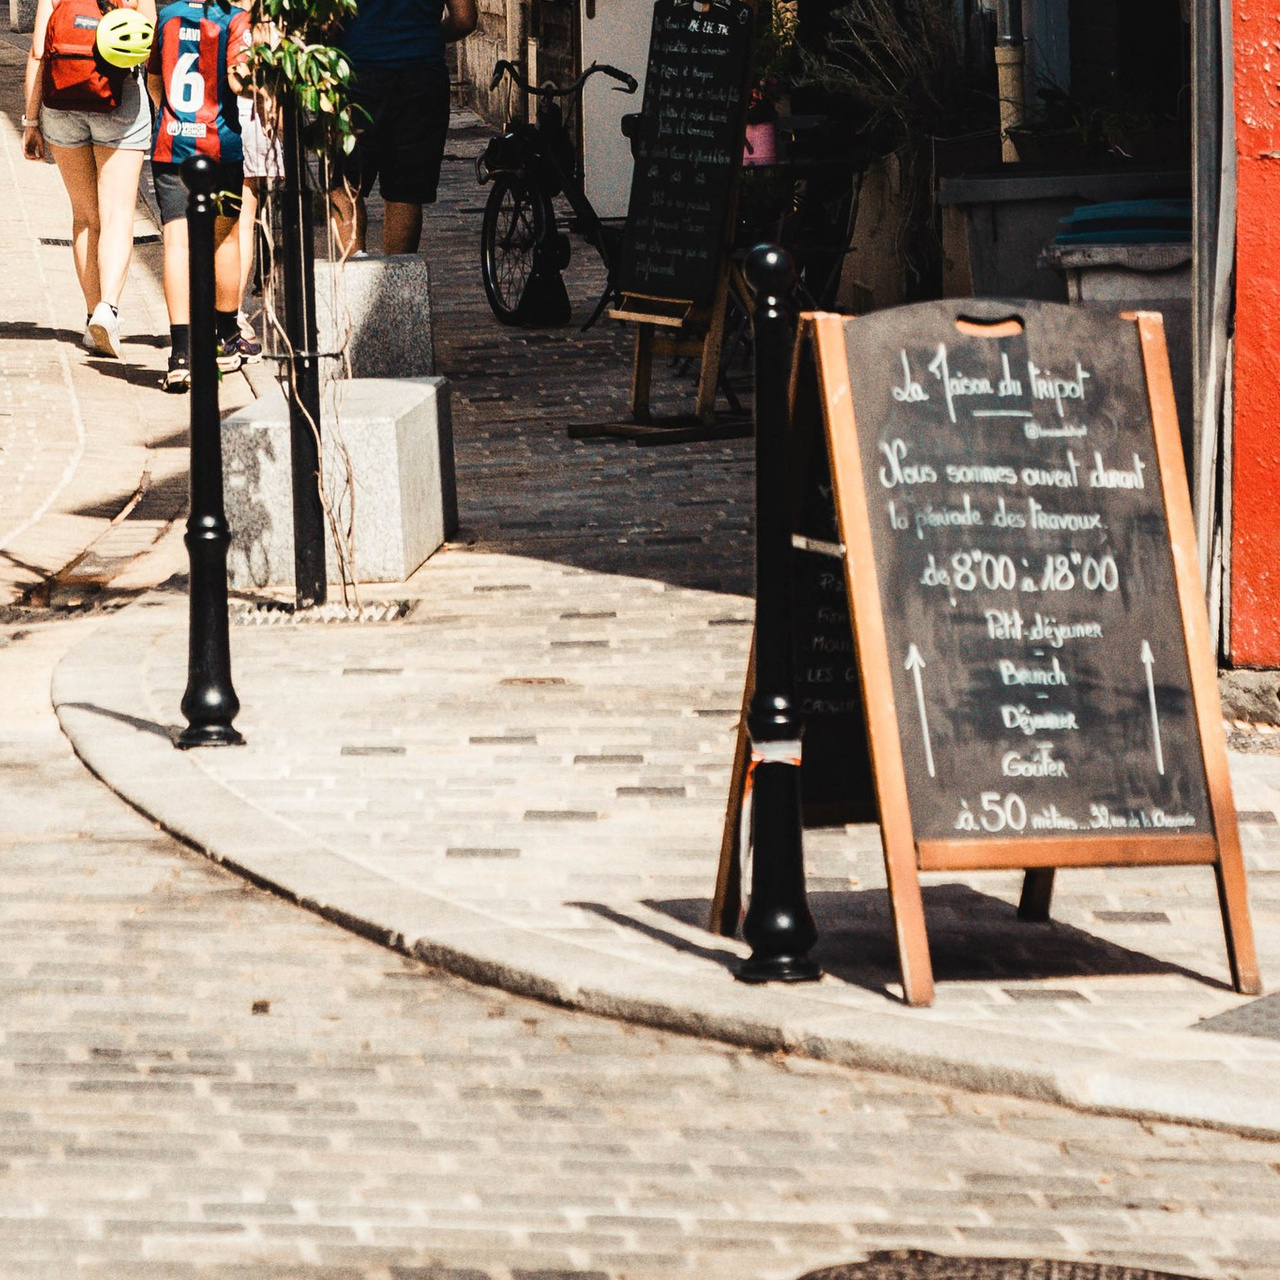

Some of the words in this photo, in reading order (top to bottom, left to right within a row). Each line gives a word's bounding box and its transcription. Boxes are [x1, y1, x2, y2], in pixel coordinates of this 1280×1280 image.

[170, 52, 205, 113] 6
[893, 349, 930, 402] La
[998, 352, 1022, 397] du
[879, 438, 937, 488] Nous
[946, 464, 1018, 485] sommes
[1022, 450, 1081, 487] ouvert
[1090, 451, 1146, 489] durant
[889, 500, 908, 530] la
[992, 495, 1026, 528] des
[920, 553, 950, 587] de
[999, 656, 1068, 686] Brunch
[980, 791, 1028, 833] 50
